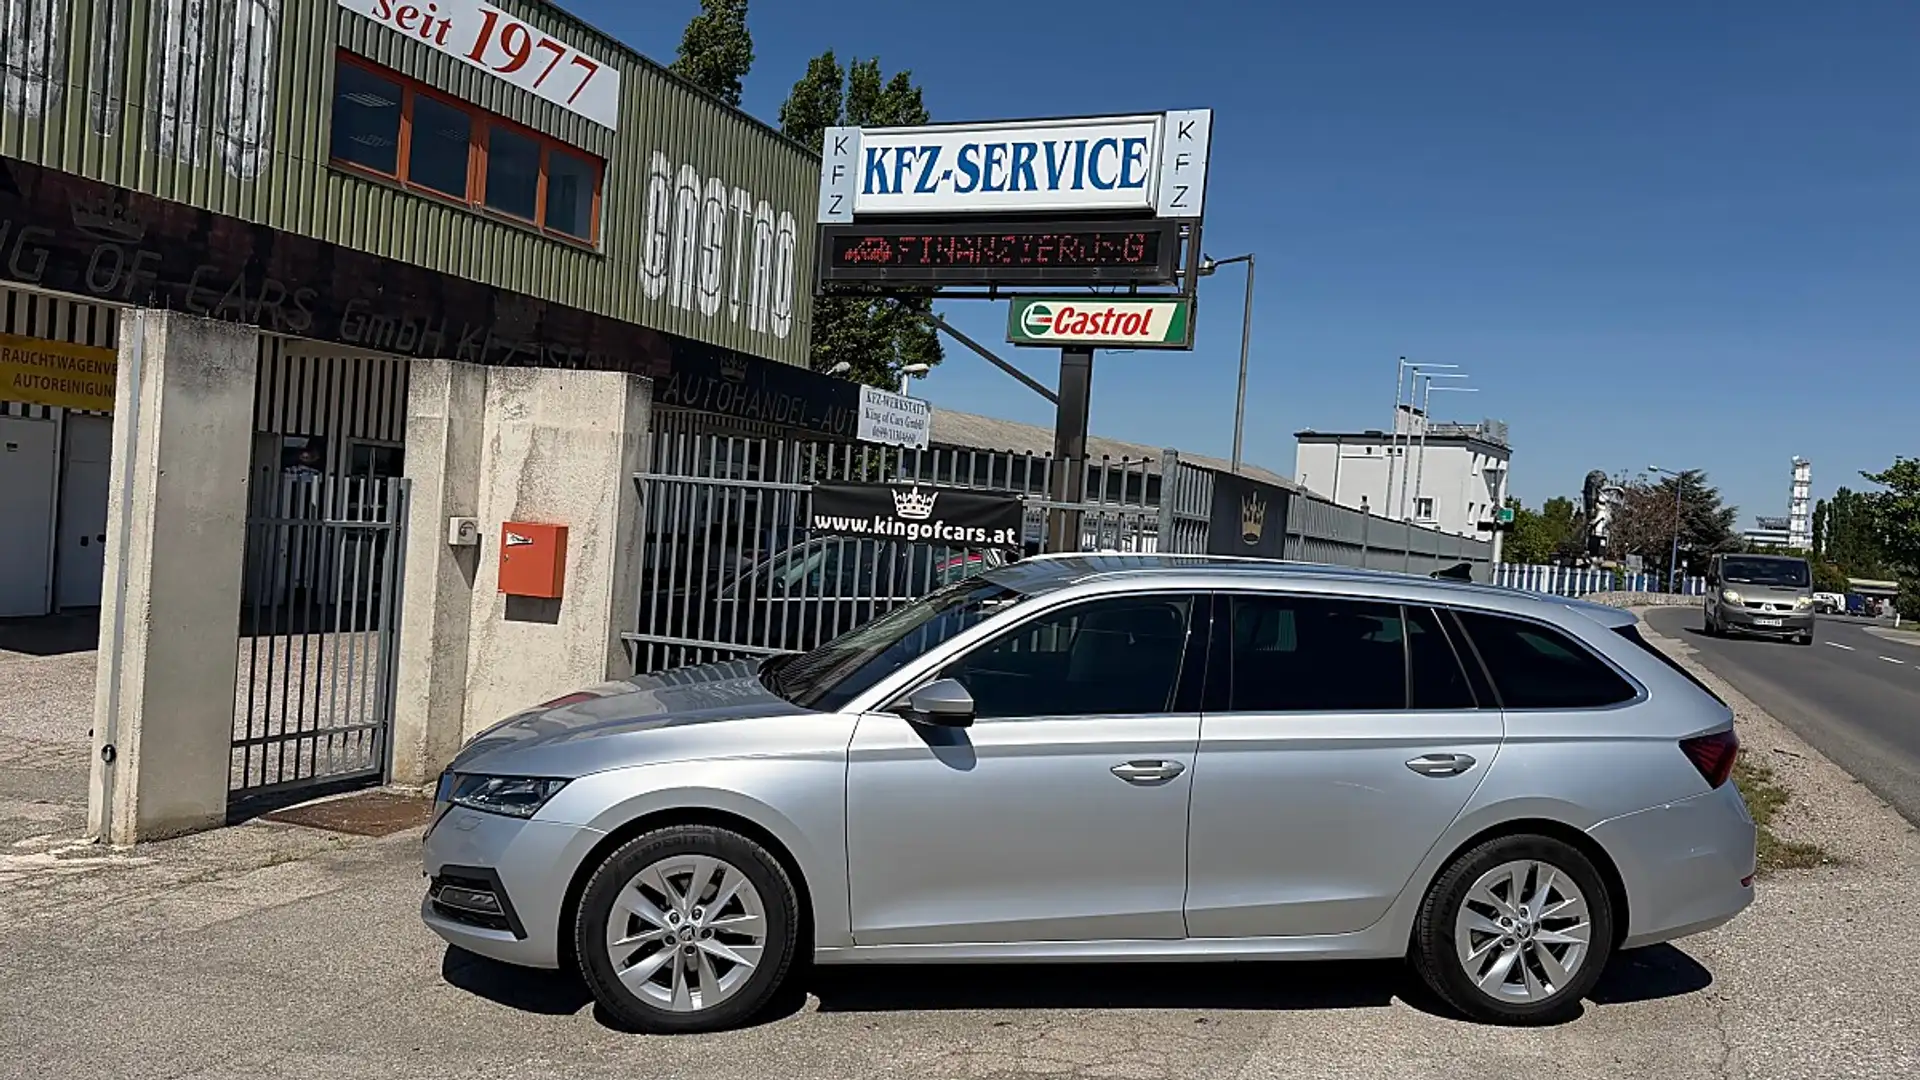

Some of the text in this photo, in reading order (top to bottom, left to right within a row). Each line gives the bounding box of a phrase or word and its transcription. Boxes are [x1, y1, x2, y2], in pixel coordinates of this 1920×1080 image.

[372, 0, 600, 105] seit 1977
[828, 135, 850, 215] KFZ
[861, 137, 1149, 195] KFZ-SERVICE
[1169, 120, 1196, 209] KFZ
[85, 243, 163, 301] OF
[184, 264, 320, 331] CARS
[339, 297, 447, 360] GmbH
[1054, 306, 1153, 336] Castrol
[13, 373, 116, 398] AUTOREINIGUN
[865, 407, 881, 424] King
[814, 515, 1017, 545] www.kingofcars.at
